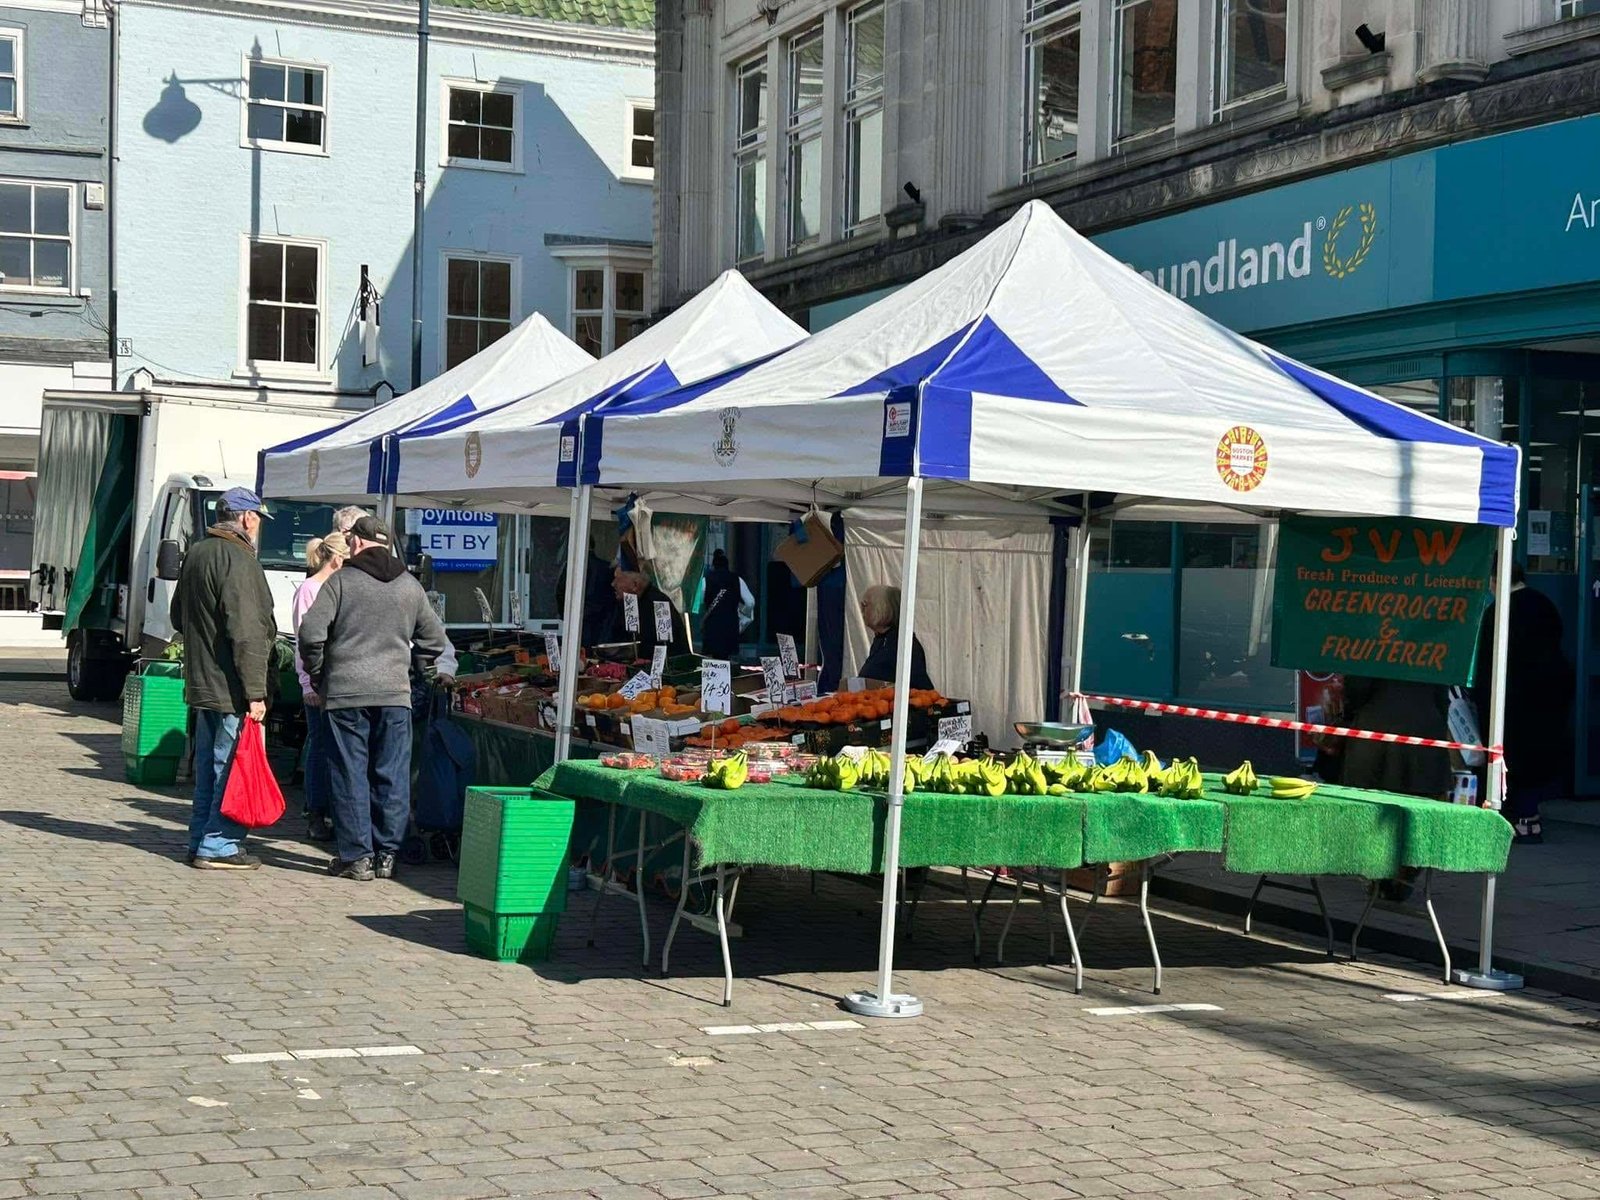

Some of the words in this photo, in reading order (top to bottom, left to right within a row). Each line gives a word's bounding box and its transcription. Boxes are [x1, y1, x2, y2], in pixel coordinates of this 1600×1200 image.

[1123, 221, 1312, 299] undland
[419, 509, 494, 524] oyntons
[463, 535, 490, 551] BY
[1297, 567, 1335, 582] Fresh
[1342, 569, 1399, 585] Produce
[1403, 573, 1419, 587] of
[1424, 574, 1484, 590] Leicester
[1304, 587, 1468, 624] GREENGROCER
[1379, 618, 1400, 638] &
[1320, 635, 1448, 671] FRUITERER
